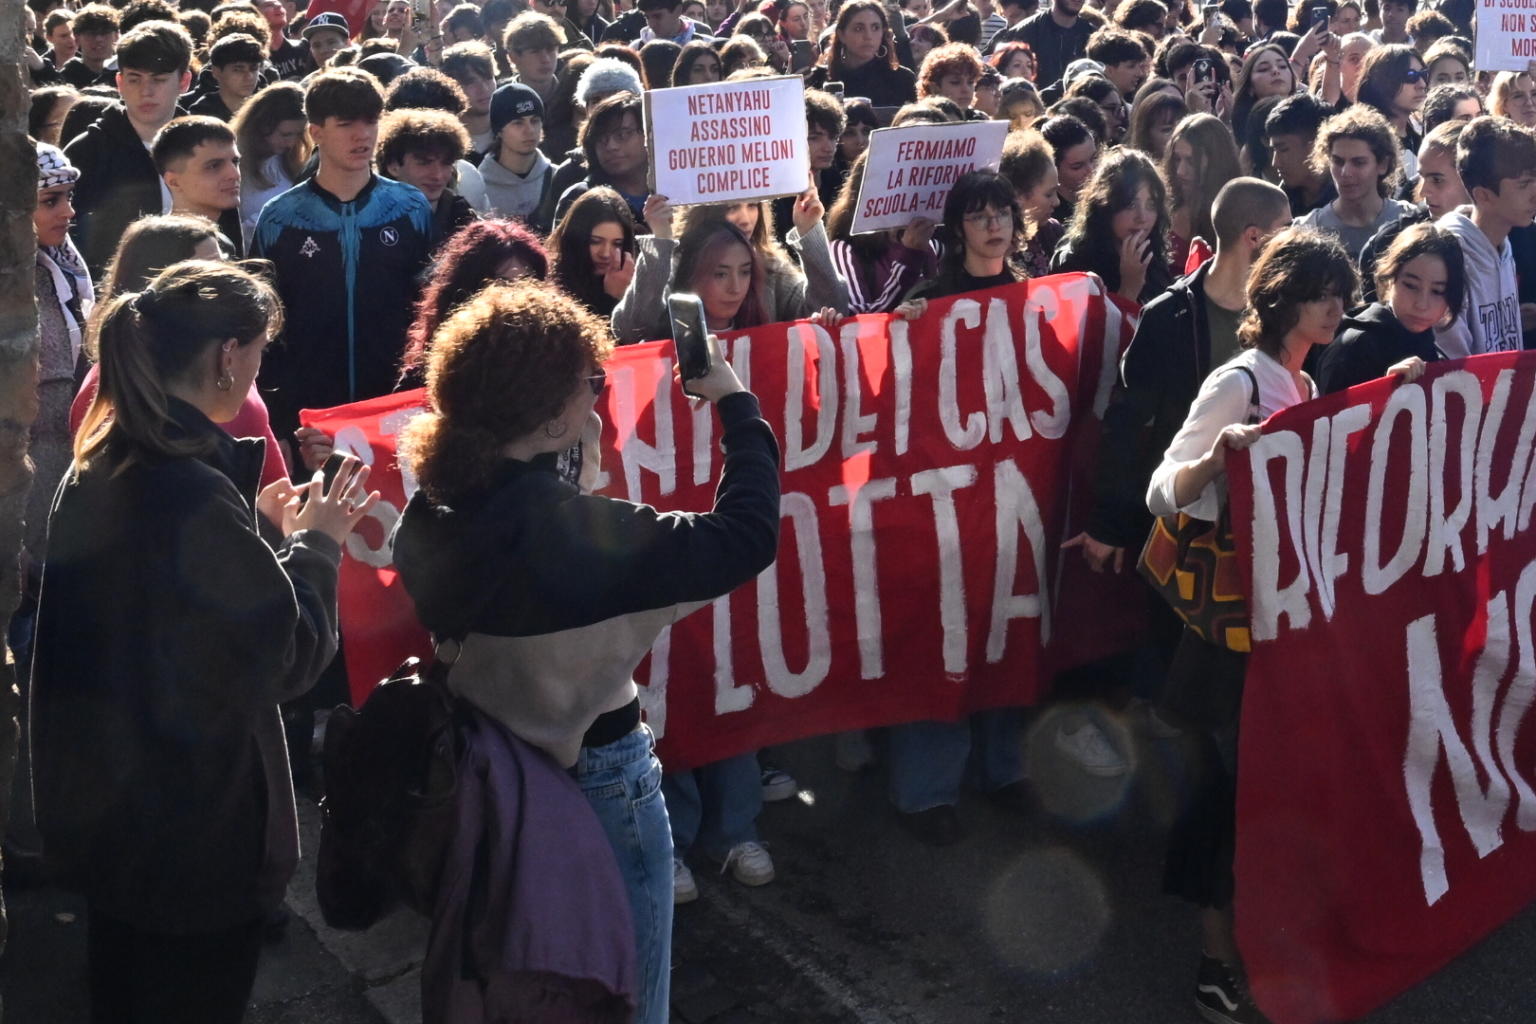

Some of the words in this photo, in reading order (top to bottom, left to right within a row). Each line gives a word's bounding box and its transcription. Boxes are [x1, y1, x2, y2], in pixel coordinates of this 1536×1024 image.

[1502, 14, 1525, 32] NON
[688, 90, 770, 115] NETANYAHU
[691, 115, 771, 142] ASSASSINO
[669, 144, 735, 170] GOVERNO
[742, 139, 794, 163] MELONI
[897, 136, 976, 162] FERMIAMO
[697, 167, 770, 194] COMPLICE
[887, 169, 903, 190] LA
[864, 190, 948, 218] SCUOLA-AZ
[786, 320, 912, 471] DEI
[938, 278, 1122, 451] CAST
[712, 456, 1052, 716] LOTTA
